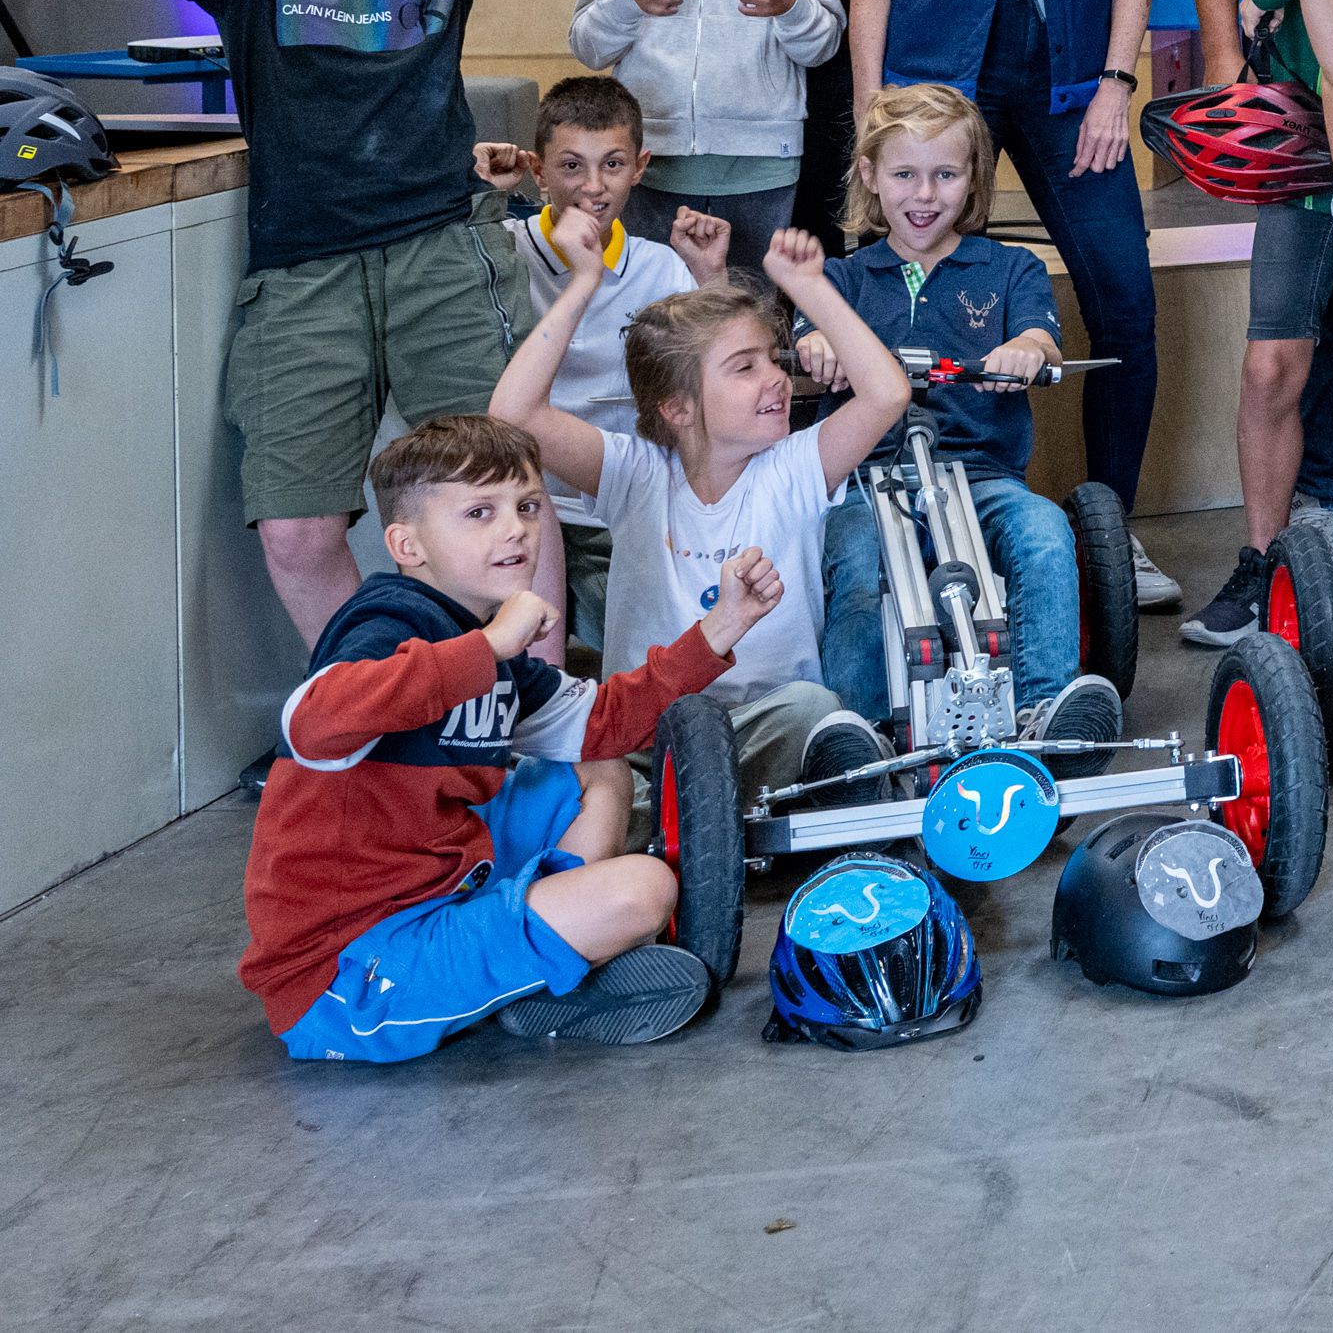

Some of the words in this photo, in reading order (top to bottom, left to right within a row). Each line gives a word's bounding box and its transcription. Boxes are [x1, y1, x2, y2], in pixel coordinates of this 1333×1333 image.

[356, 11, 393, 25] JEANS
[1282, 119, 1312, 136] uvex
[438, 738, 450, 746] The
[450, 739, 480, 748] National
